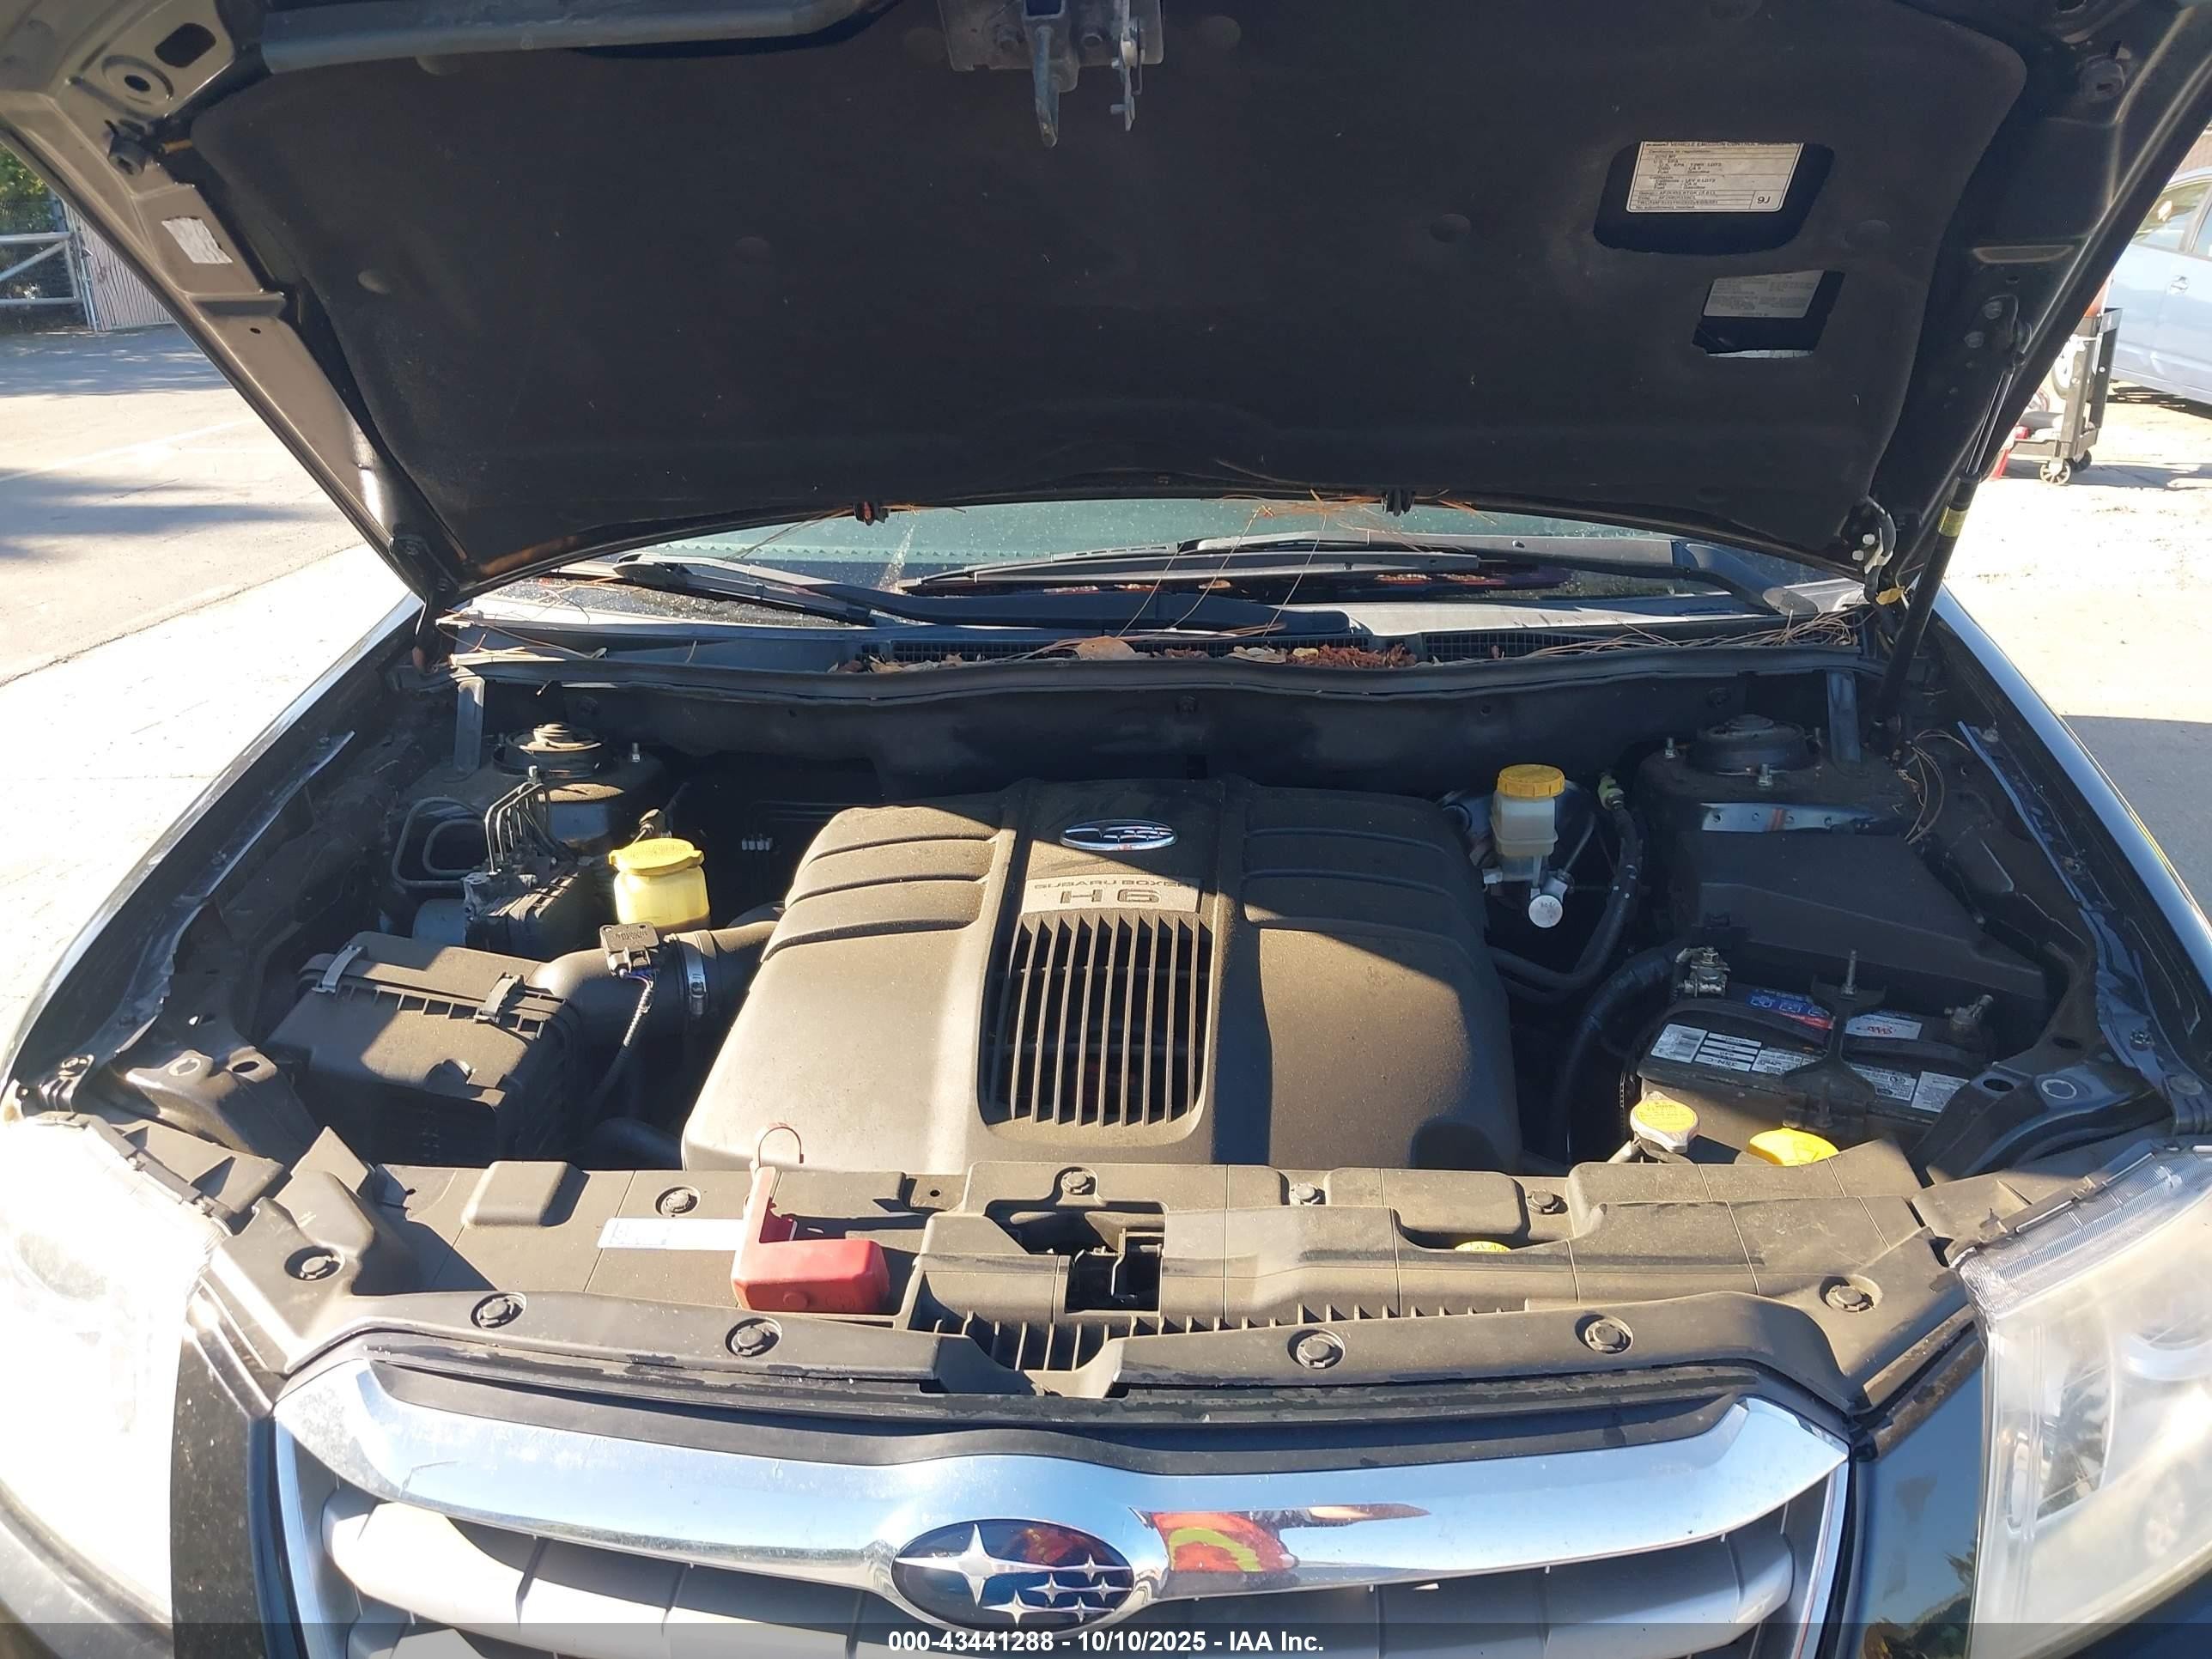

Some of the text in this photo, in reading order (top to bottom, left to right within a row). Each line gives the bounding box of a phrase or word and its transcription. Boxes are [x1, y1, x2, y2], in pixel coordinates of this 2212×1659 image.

[1757, 196, 1771, 204] 9J
[1034, 879, 1117, 890] SUBARU
[1060, 888, 1162, 904] H6
